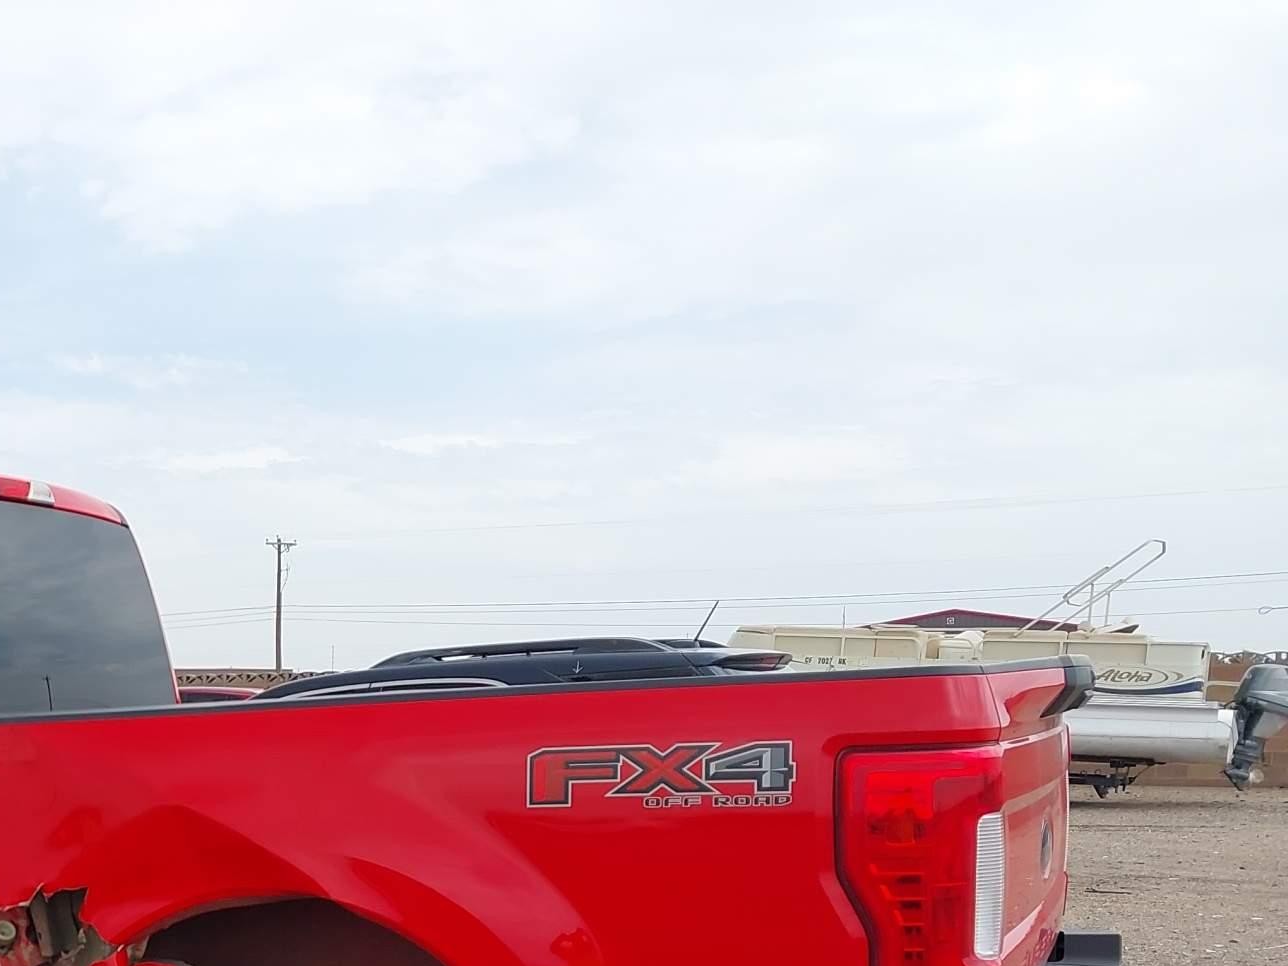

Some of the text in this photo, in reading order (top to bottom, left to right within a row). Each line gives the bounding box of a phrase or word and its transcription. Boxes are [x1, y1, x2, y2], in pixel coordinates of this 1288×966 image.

[526, 740, 797, 808] FX4
[643, 795, 793, 808] OFF ROAD
